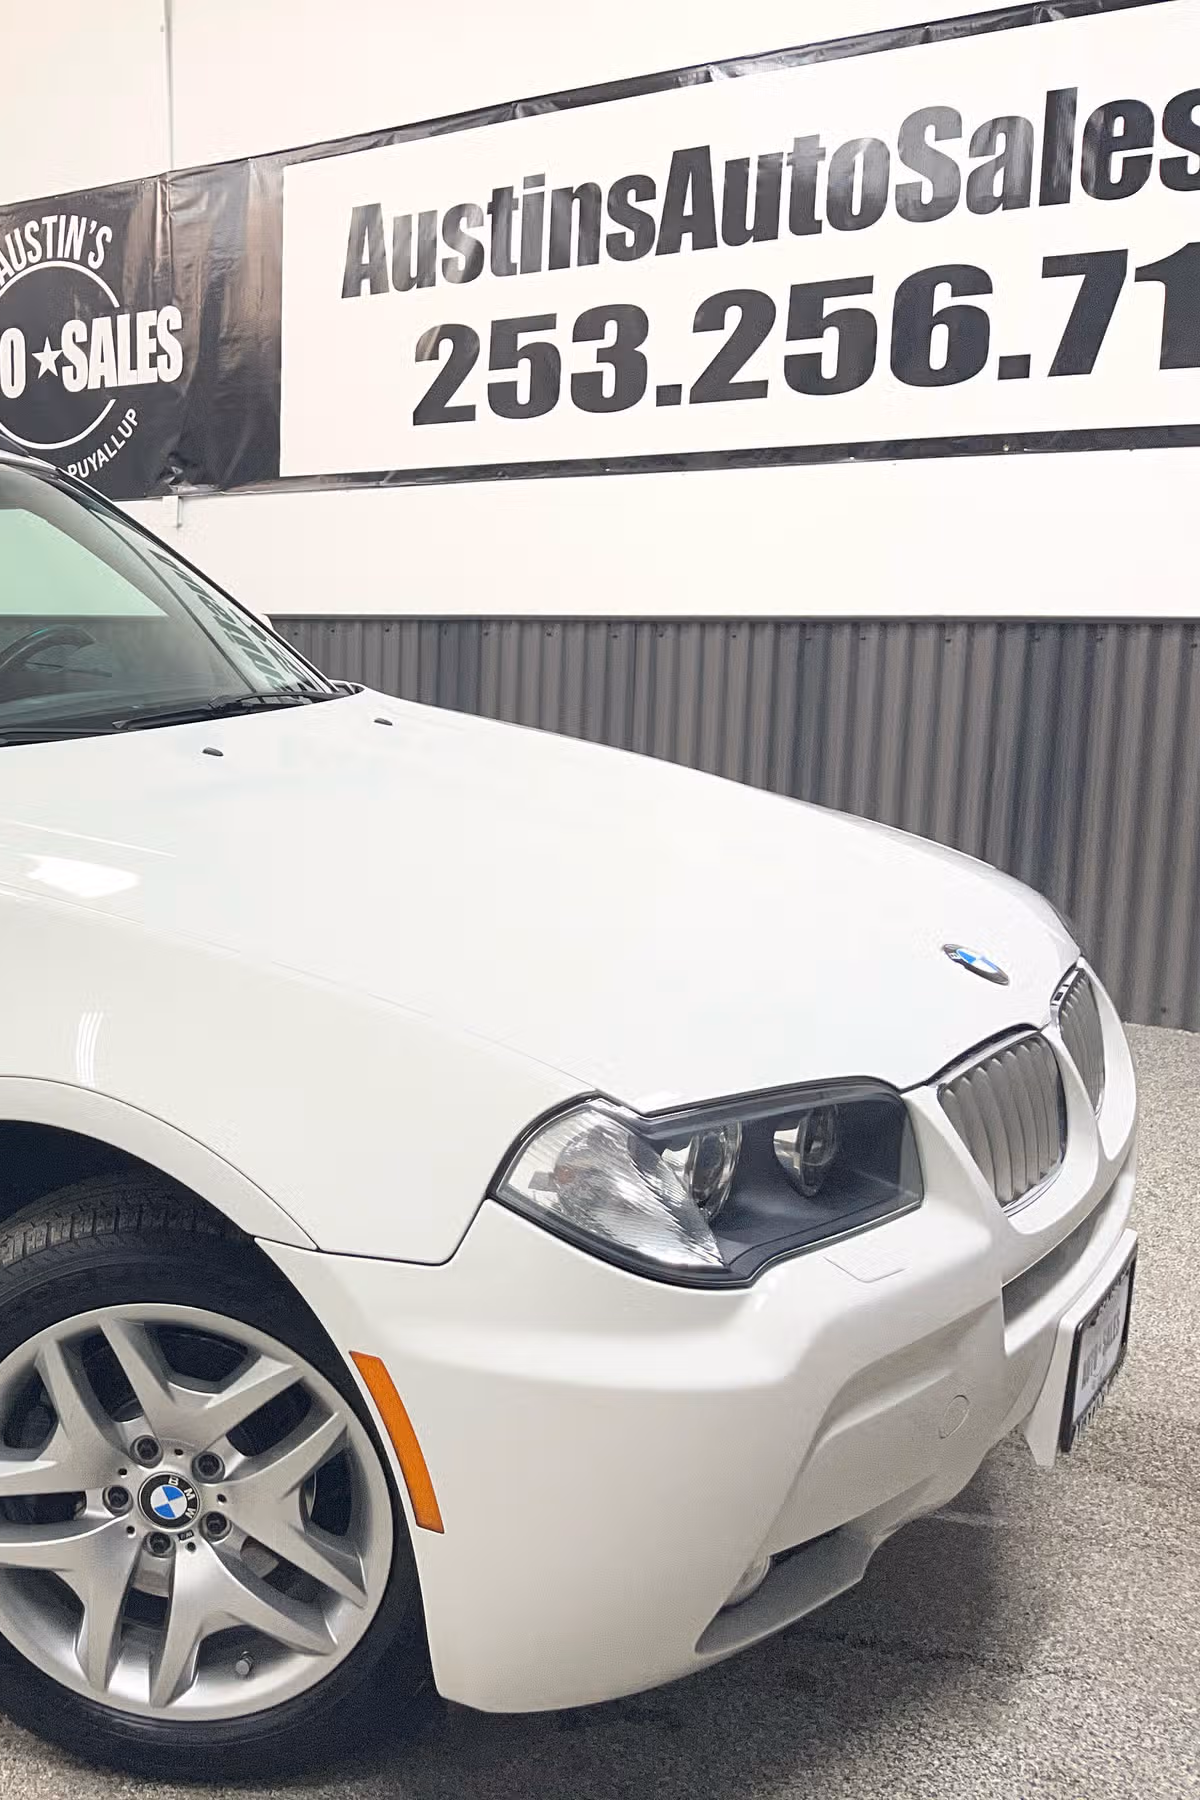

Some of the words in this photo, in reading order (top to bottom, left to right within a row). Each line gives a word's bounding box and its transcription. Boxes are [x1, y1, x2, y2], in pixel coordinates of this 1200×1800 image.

[341, 86, 1200, 299] AustinsAutoSales
[60, 305, 183, 393] SALES
[413, 241, 1200, 426] 253.256.71
[67, 408, 138, 478] PUYALLUP
[168, 1475, 196, 1519] BMW
